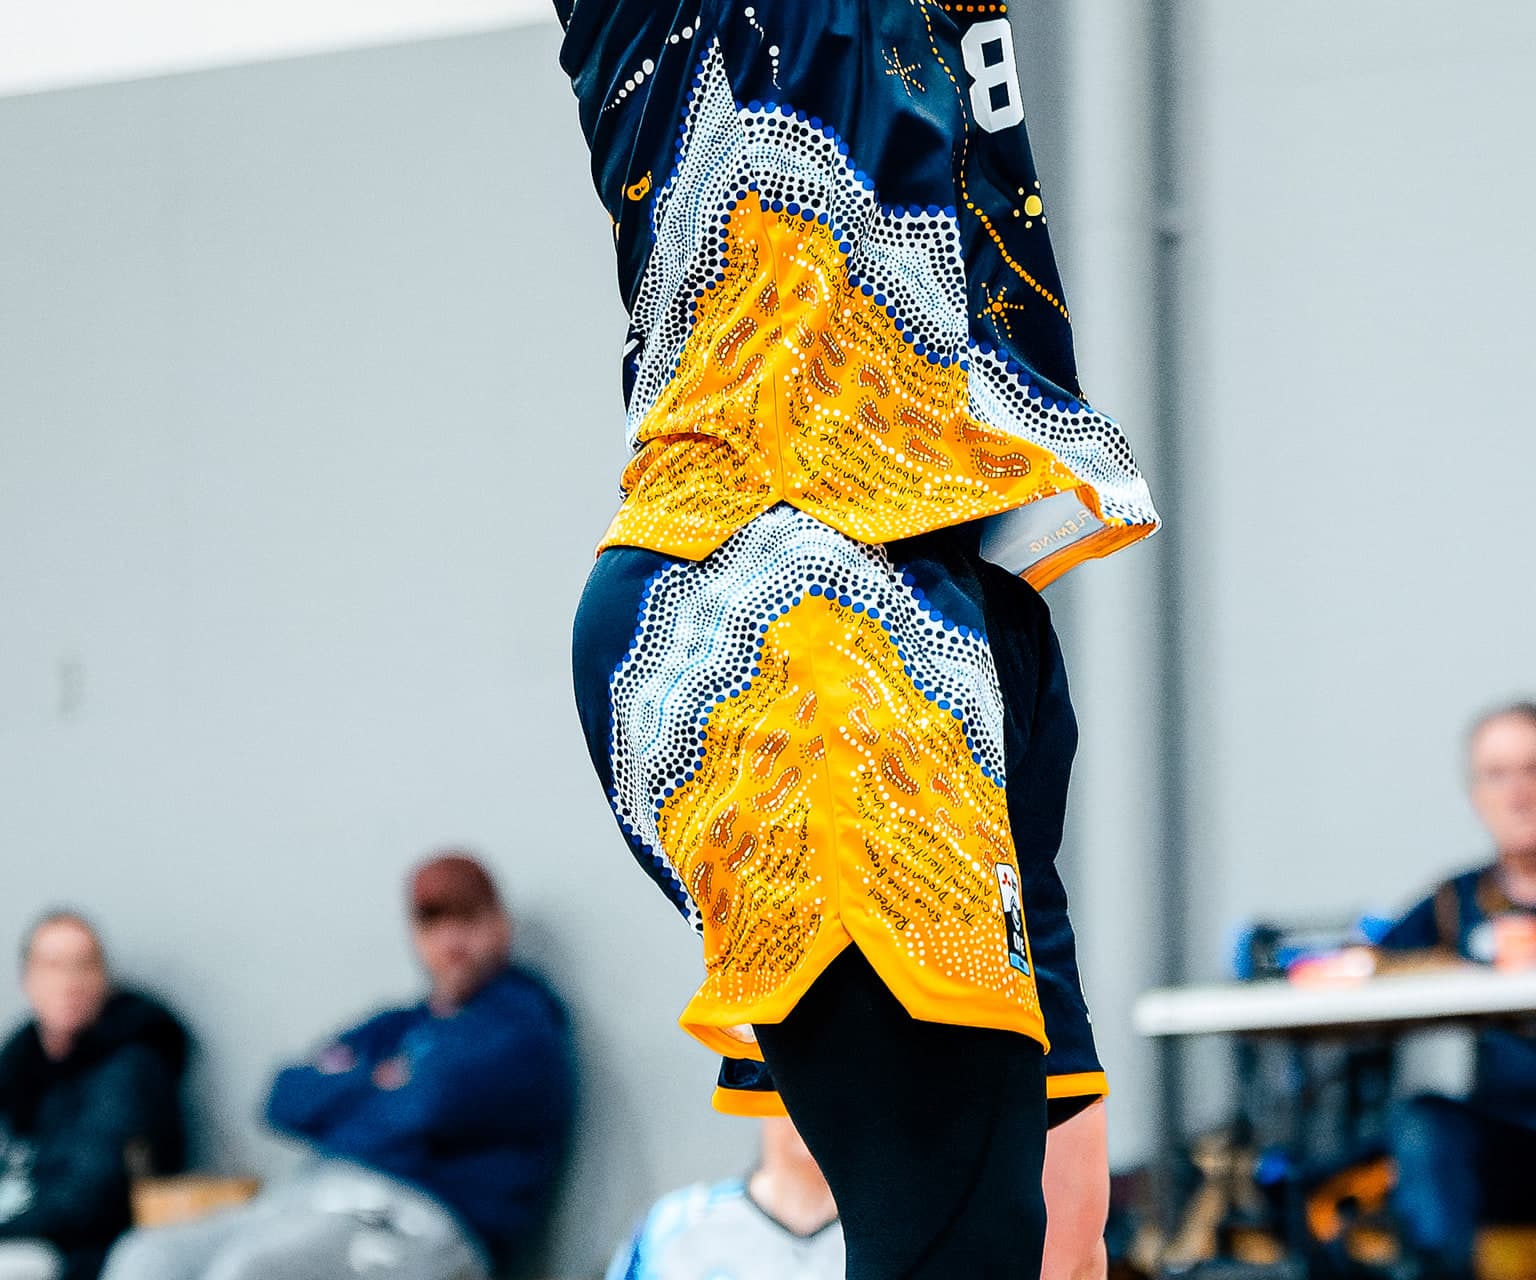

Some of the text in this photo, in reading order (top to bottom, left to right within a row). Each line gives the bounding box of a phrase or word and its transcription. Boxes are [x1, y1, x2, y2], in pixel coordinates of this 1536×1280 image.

[777, 213, 807, 233] Sites
[738, 244, 759, 283] Future
[869, 305, 890, 331] Kids
[825, 418, 862, 442] Nation
[820, 434, 870, 473] Heritage
[863, 442, 922, 491] Aboriginal
[822, 455, 877, 500] Dreaming
[859, 614, 894, 658] Sacred
[860, 772, 884, 809] Unity
[899, 816, 938, 843] Nation
[893, 833, 945, 875] Heritage
[930, 843, 1000, 896] Aboriginal
[888, 877, 909, 901] time
[891, 853, 975, 927] The Dreaming
[868, 888, 910, 930] Respect
